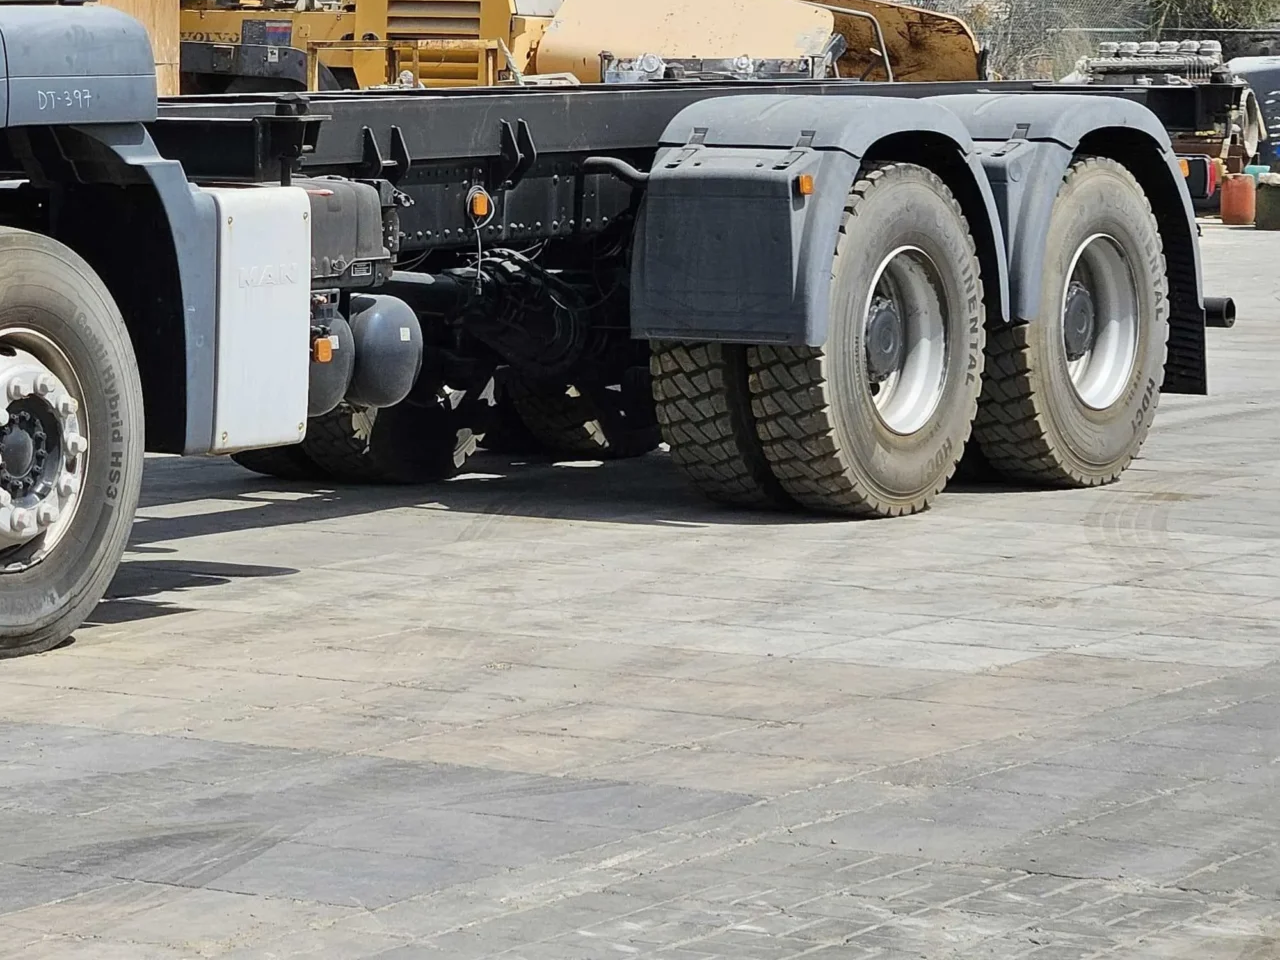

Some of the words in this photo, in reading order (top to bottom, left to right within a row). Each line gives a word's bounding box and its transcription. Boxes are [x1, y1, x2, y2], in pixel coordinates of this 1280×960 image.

[37, 89, 92, 110] DT-397
[239, 263, 300, 289] MAN
[102, 364, 124, 437] Hybrid
[105, 452, 124, 500] HS3
